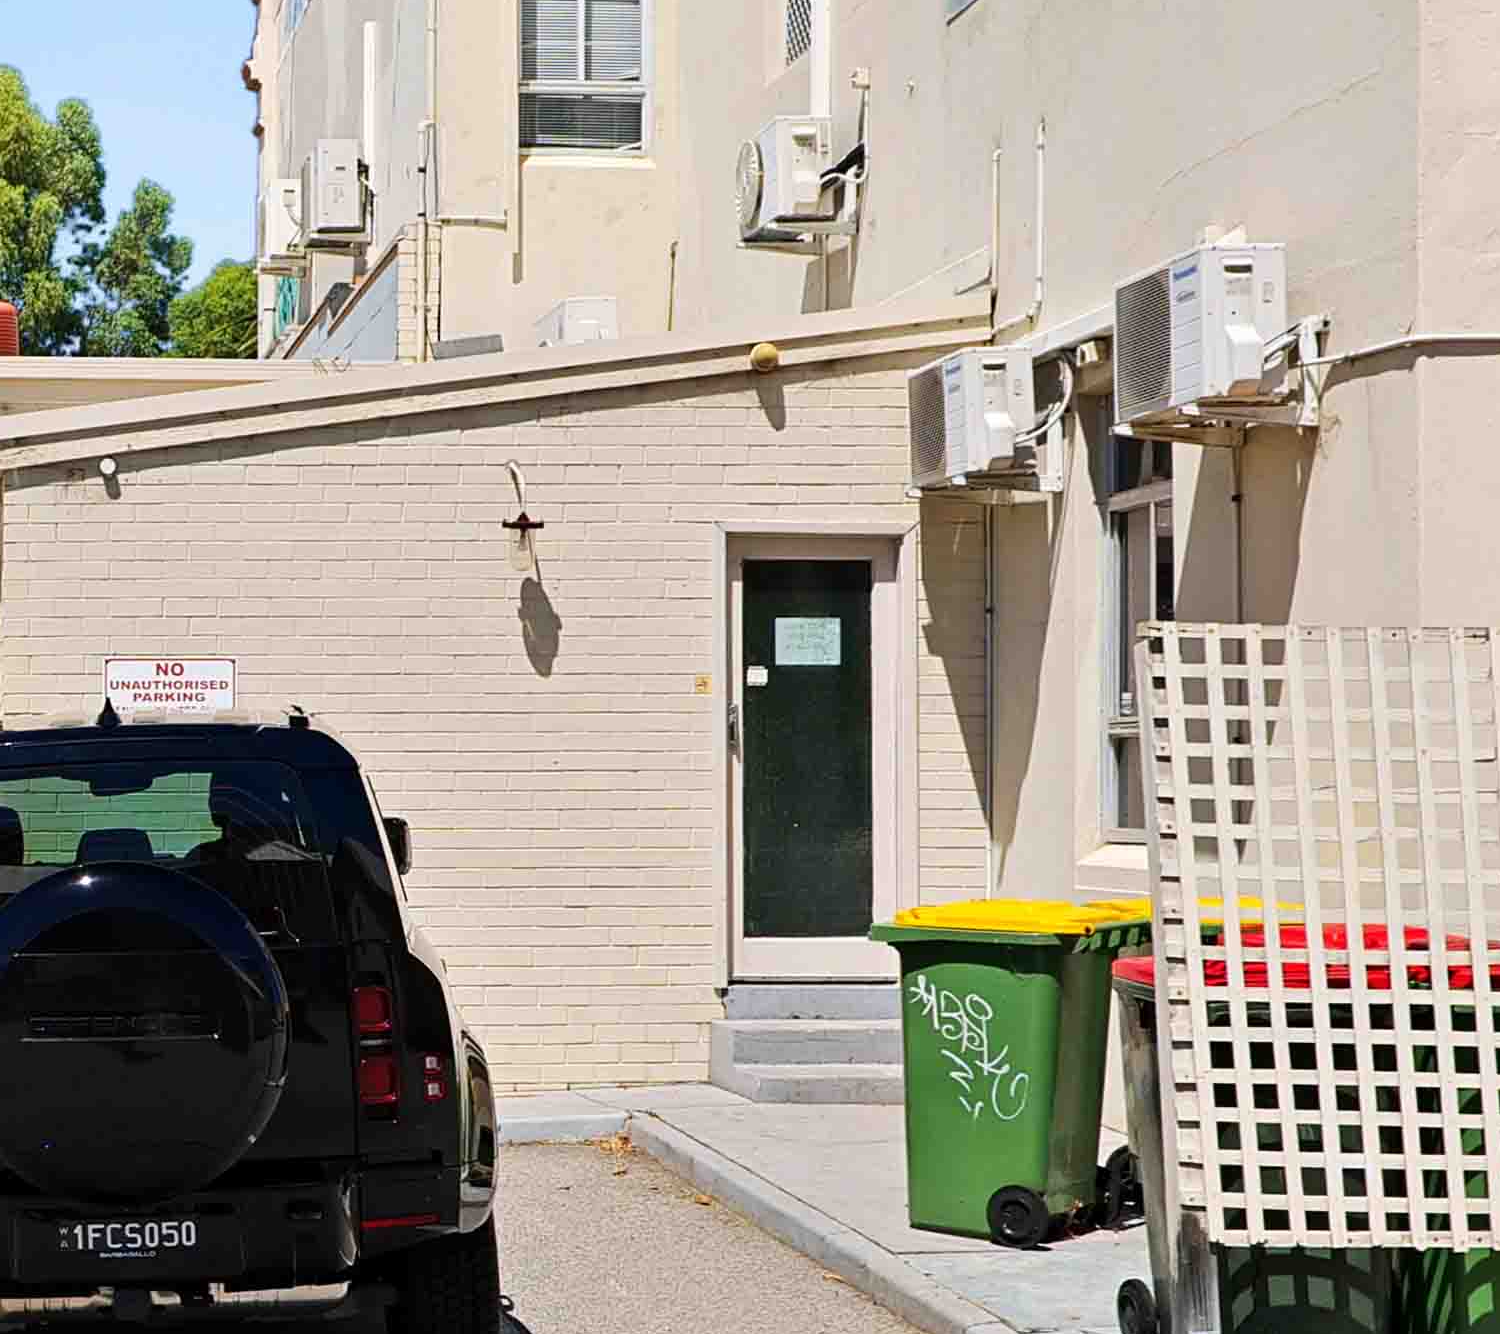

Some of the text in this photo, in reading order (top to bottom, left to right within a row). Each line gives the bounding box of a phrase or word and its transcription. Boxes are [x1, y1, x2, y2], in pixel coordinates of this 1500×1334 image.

[155, 663, 185, 676] NO
[109, 680, 229, 690] UNAUTHORISED
[133, 693, 206, 702] PARKING
[73, 1221, 196, 1250] 1FCS050
